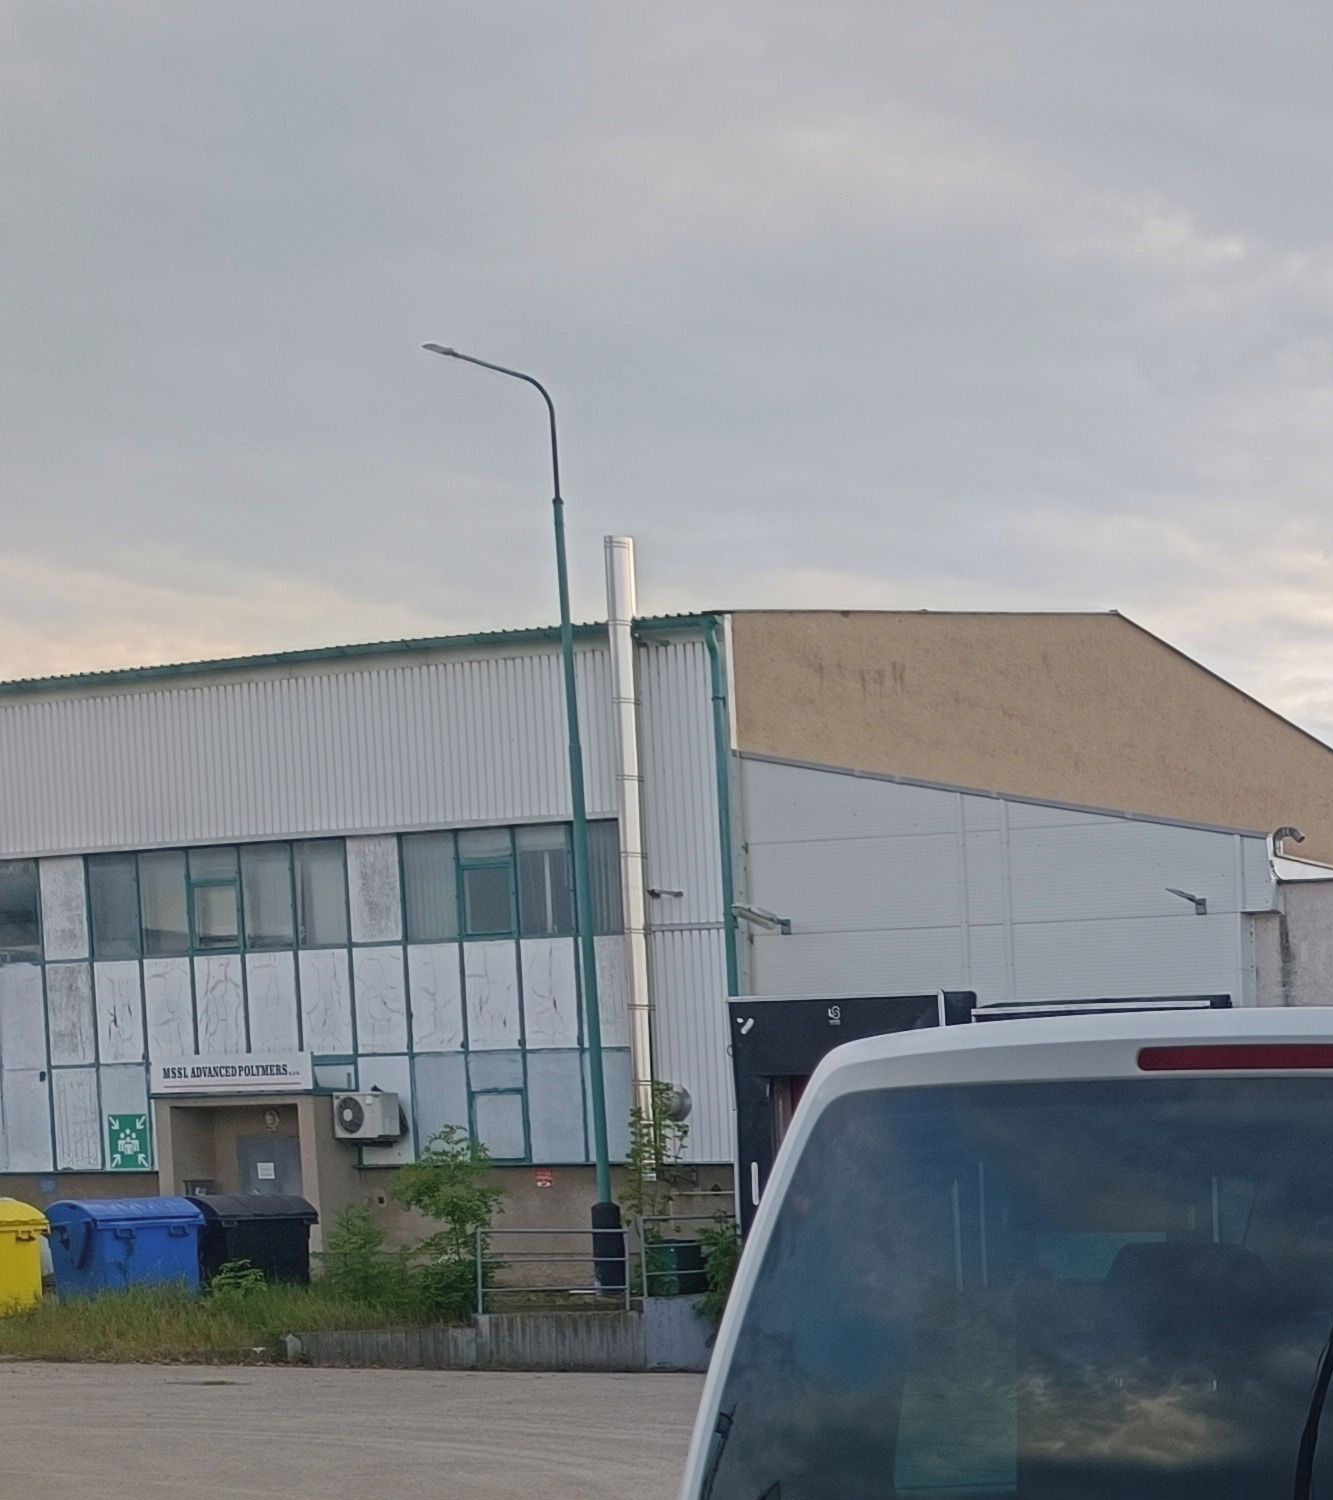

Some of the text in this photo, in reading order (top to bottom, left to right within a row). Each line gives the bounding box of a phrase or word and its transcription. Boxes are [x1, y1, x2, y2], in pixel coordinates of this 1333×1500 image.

[162, 1067, 189, 1079] MSSL
[190, 1065, 238, 1078] ADVANCED
[238, 1064, 288, 1076] POLYMERS
